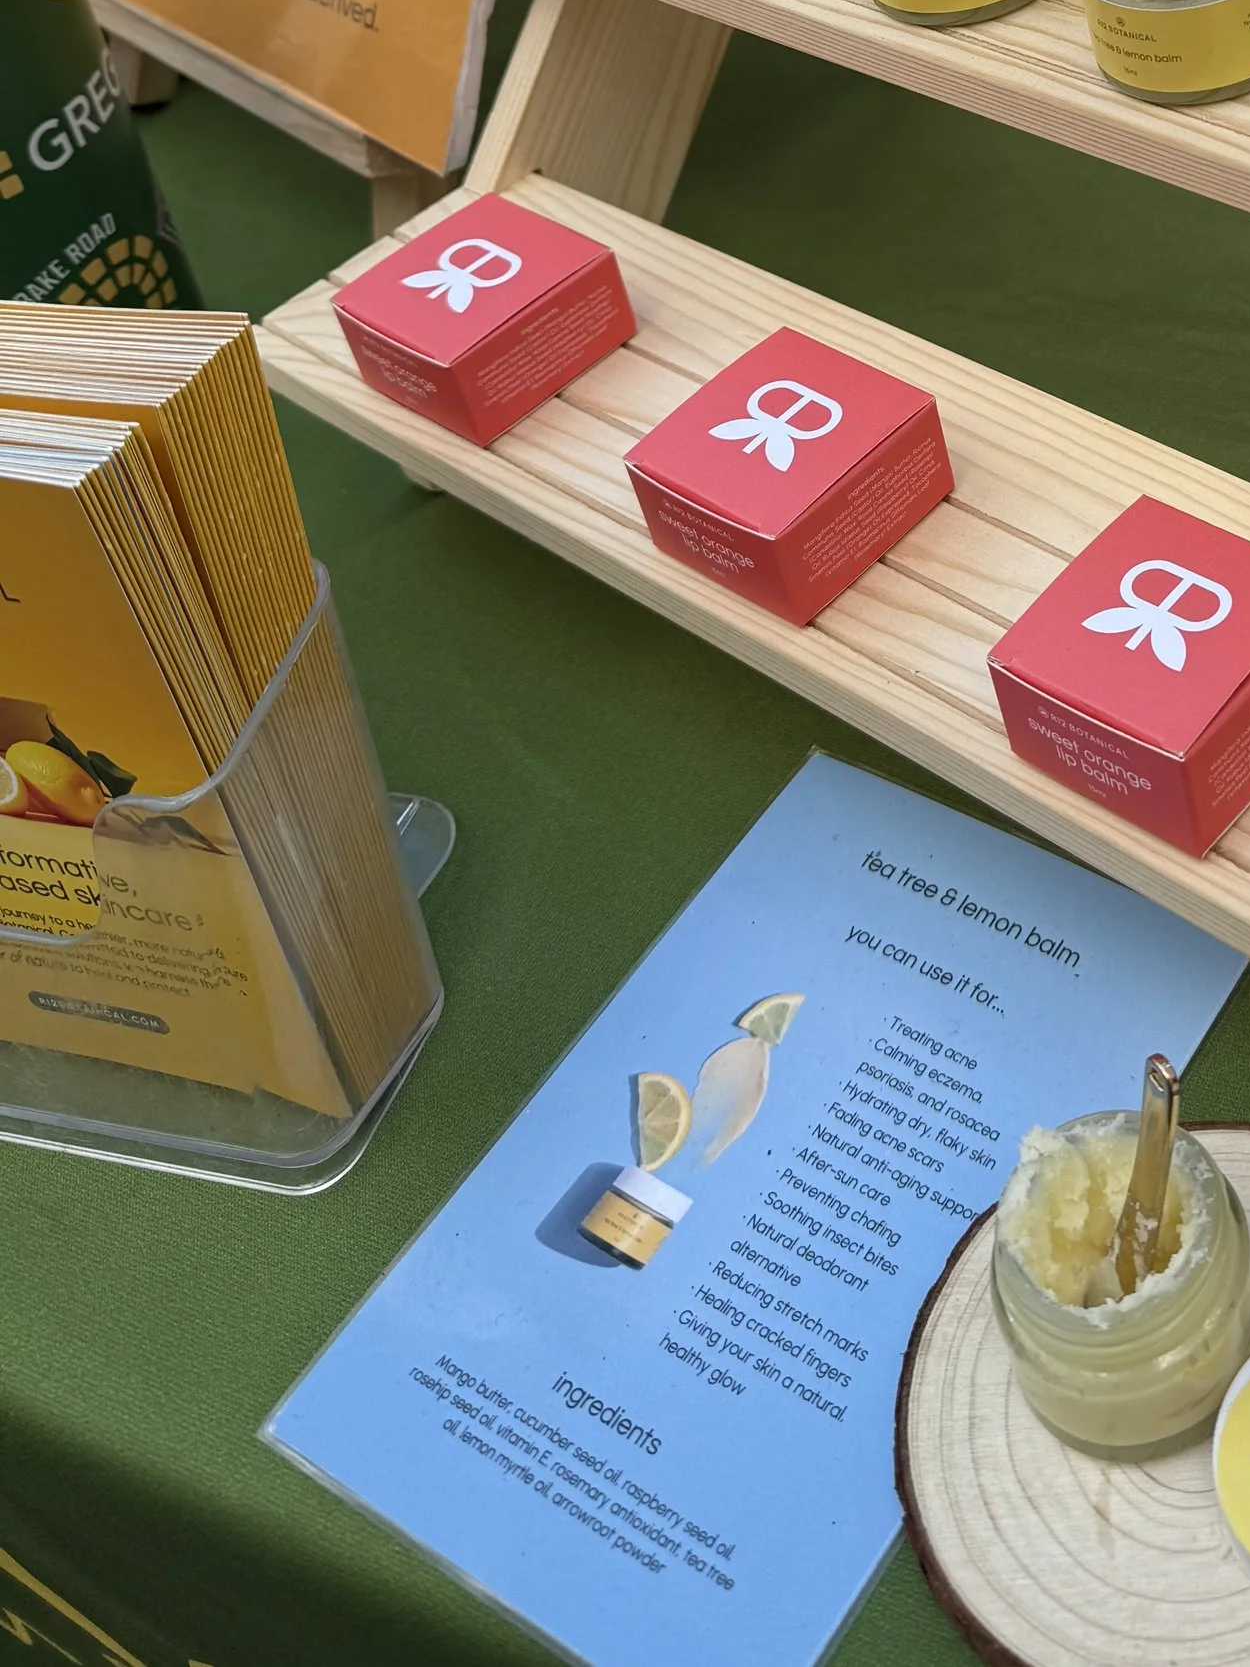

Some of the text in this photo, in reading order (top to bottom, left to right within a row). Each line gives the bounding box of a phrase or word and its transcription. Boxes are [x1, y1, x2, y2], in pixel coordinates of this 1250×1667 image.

[64, 212, 117, 265] ROAD
[1028, 718, 1151, 790] sweet orange
[1056, 745, 1128, 794] lip balm
[861, 850, 1080, 967] tea tree & lemon balm
[844, 925, 1004, 1014] you can use it for...
[874, 1037, 983, 1104] Calming eczema,
[890, 1015, 977, 1070] Treating acne
[827, 1101, 944, 1173] Fading acne scars
[842, 1079, 996, 1170] Hydrating dry, flaky skin
[855, 1061, 1001, 1142] psoriasis, and rosacea
[779, 1167, 902, 1247] Preventing chafing
[795, 1146, 891, 1206] After-sun care
[811, 1123, 980, 1222] Natural anti-aging suppor
[730, 1240, 801, 1287] alternative
[746, 1213, 869, 1292] Natural deodorant
[764, 1191, 899, 1276] Soothing insect bites
[694, 1284, 852, 1387] Healing cracked fingers
[711, 1260, 869, 1362] Reducing stretch marks
[658, 1332, 746, 1395] healthy glow
[678, 1309, 848, 1422] Giving your skin a natural,
[434, 1354, 477, 1388] Mango
[513, 1407, 575, 1451] cucumber
[572, 1446, 608, 1473] seed
[620, 1480, 684, 1528] raspberry
[683, 1521, 720, 1548] seed
[551, 1371, 662, 1455] ingredients
[408, 1367, 452, 1401] rosehip
[449, 1394, 484, 1420] seed
[496, 1424, 540, 1459] vitamin
[550, 1461, 611, 1509] rosemary
[683, 1548, 708, 1573] tea
[706, 1565, 735, 1590] tree
[458, 1426, 496, 1459] lemon
[494, 1453, 534, 1484] myrtle
[551, 1492, 616, 1540] arrowroot
[611, 1535, 667, 1574] powder
